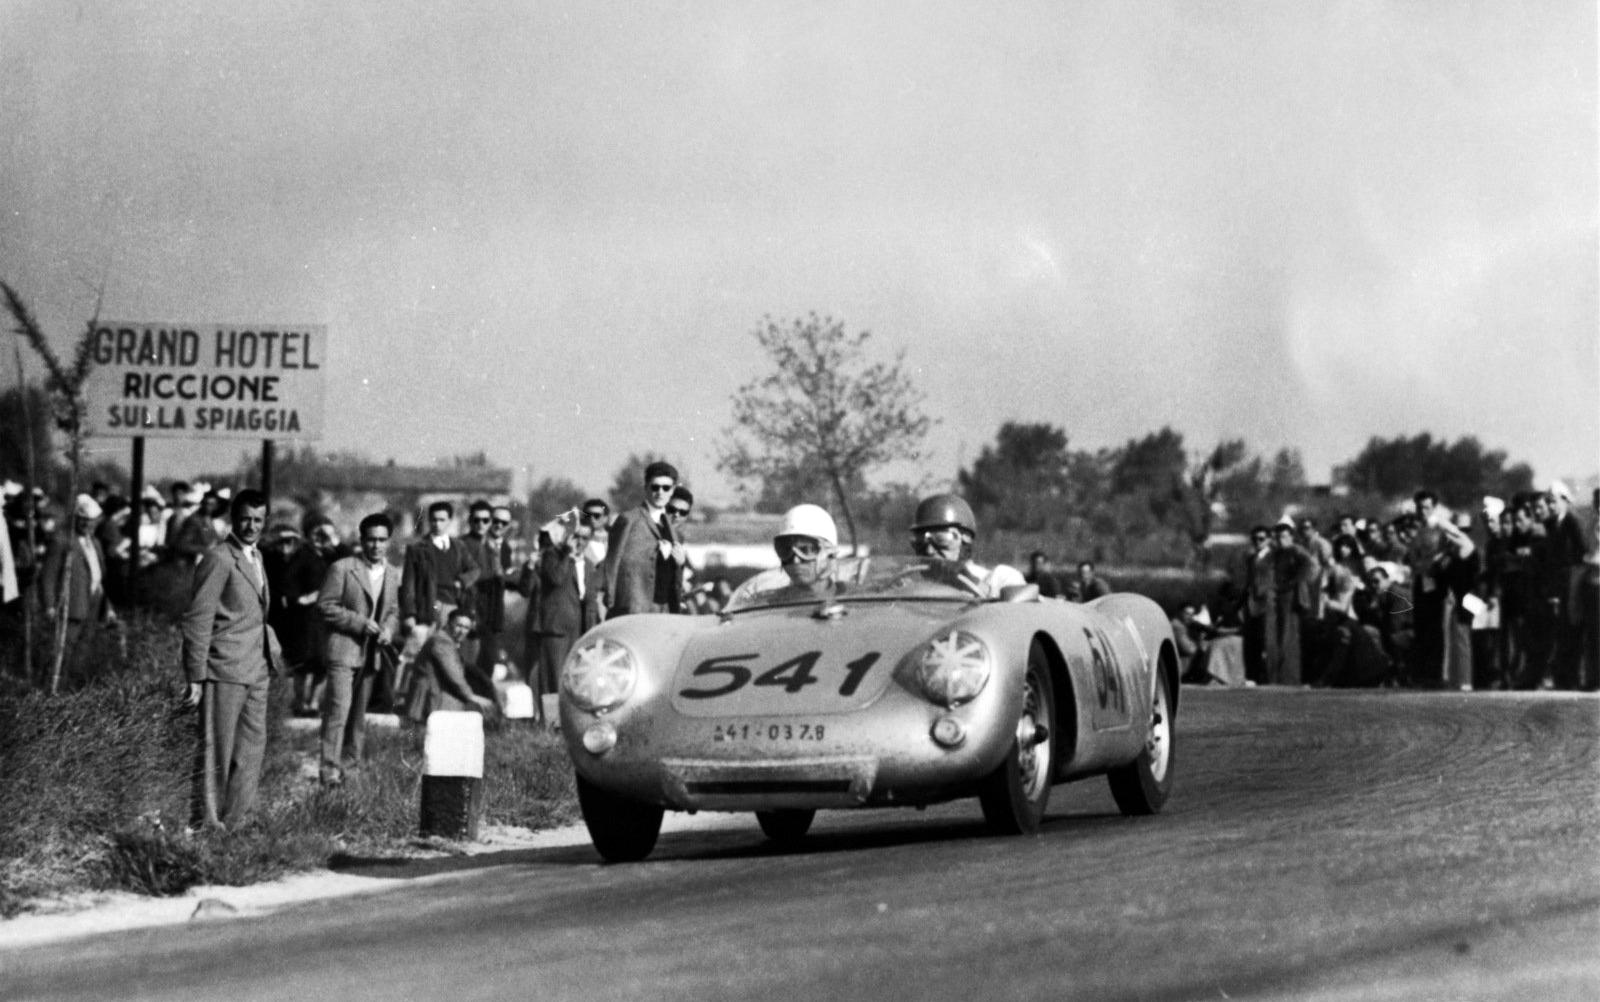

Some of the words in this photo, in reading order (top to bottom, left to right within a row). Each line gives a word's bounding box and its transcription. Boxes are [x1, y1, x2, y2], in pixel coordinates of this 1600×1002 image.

[93, 328, 199, 367] GRAND
[215, 331, 319, 369] HOTEL
[124, 372, 279, 401] RICCIONE
[108, 405, 186, 429] SULLA
[194, 407, 301, 432] SPIAGGIA
[679, 651, 882, 699] 541
